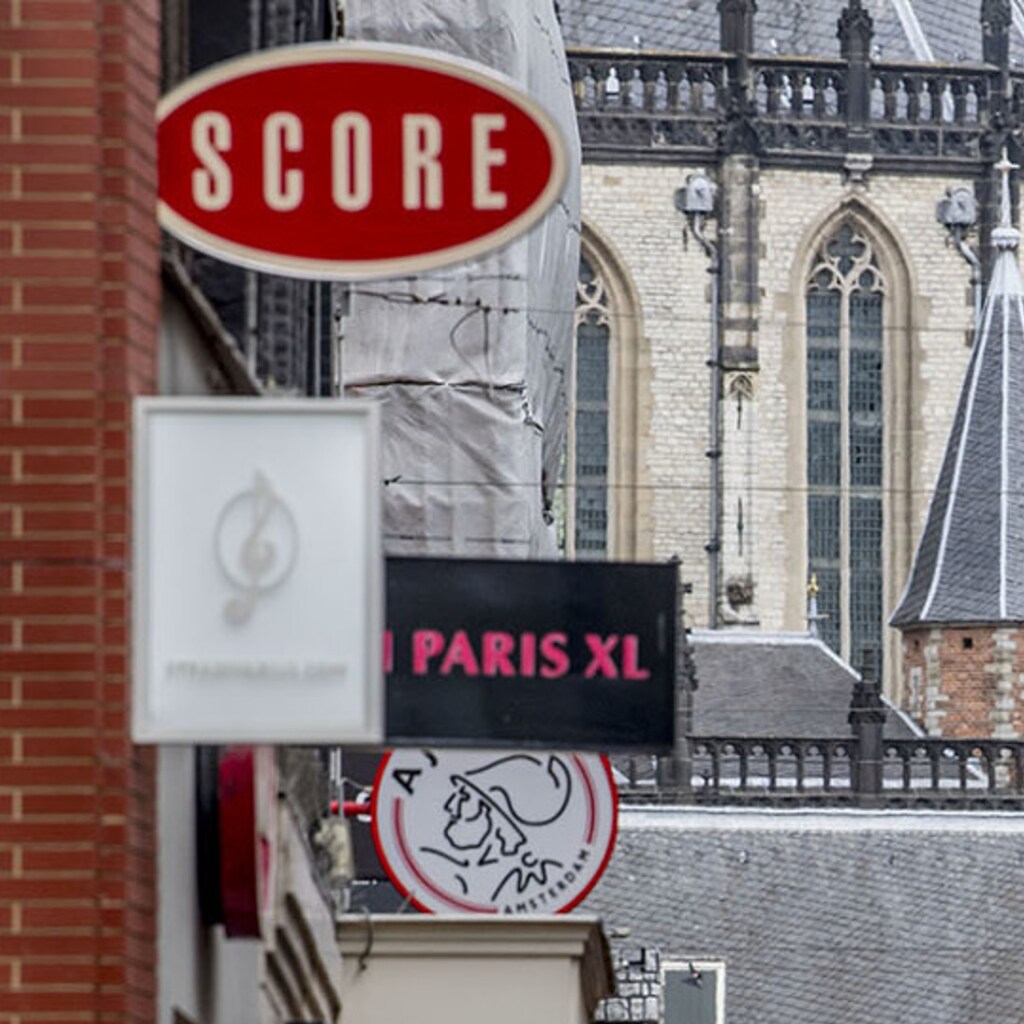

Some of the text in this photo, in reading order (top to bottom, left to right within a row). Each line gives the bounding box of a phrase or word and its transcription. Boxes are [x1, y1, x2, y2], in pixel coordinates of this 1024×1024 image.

[192, 111, 507, 212] SCORE
[413, 631, 570, 679] PARIS
[584, 634, 651, 680] XL
